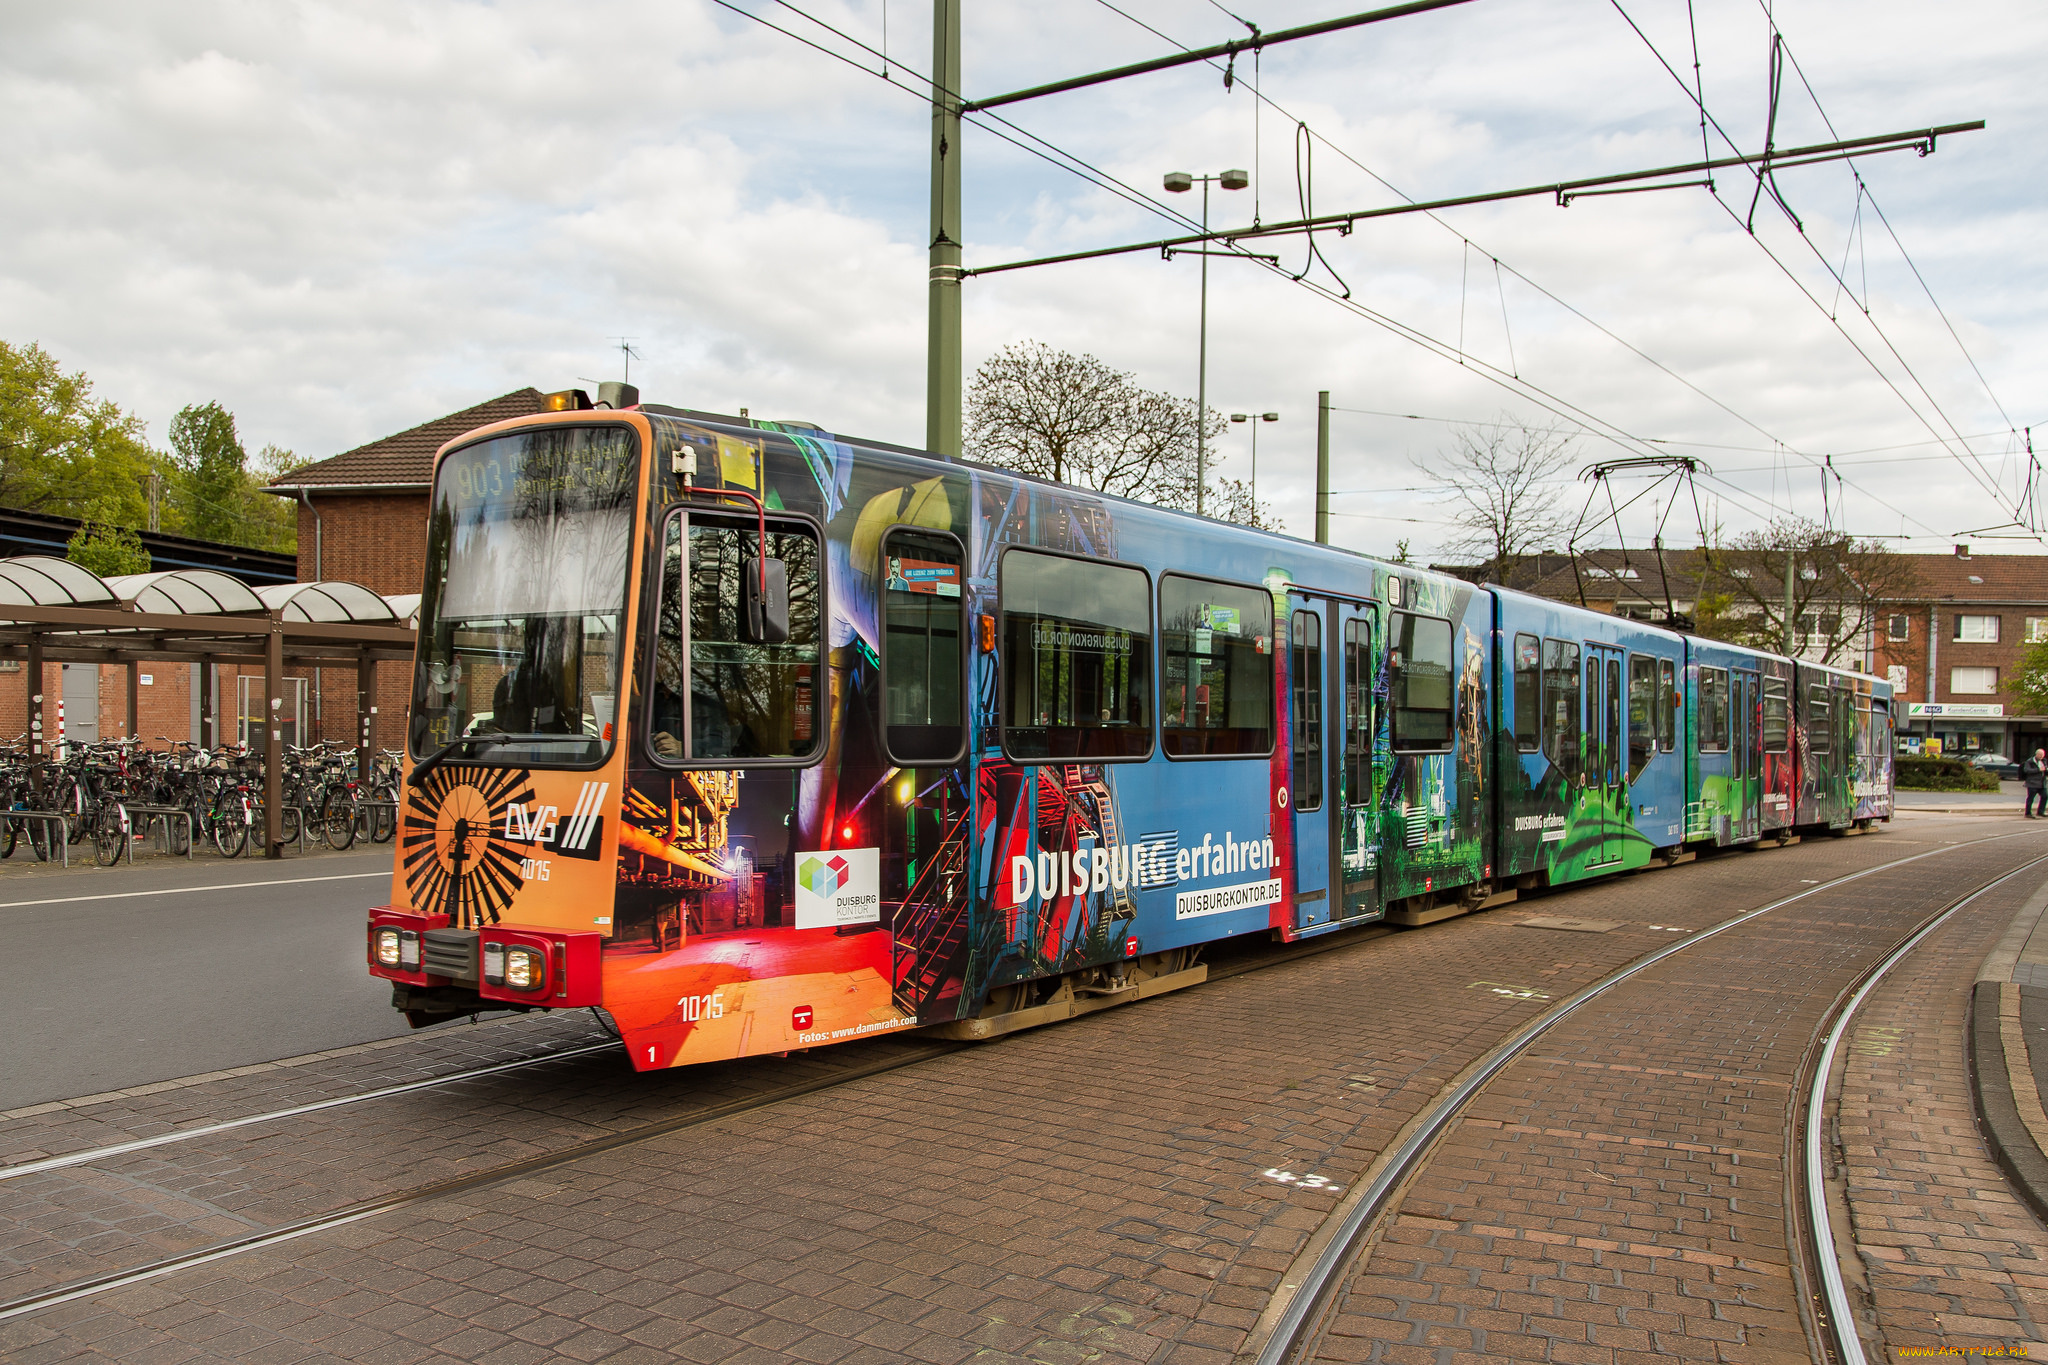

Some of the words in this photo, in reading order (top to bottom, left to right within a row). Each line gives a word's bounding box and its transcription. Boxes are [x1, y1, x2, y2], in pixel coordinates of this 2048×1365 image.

[457, 460, 503, 499] 903
[584, 466, 610, 488] Tor
[504, 803, 557, 842] DVG
[1515, 815, 1542, 831] DUISBURG
[520, 858, 551, 881] 1015
[1012, 841, 1167, 903] DUISBURG
[1176, 831, 1280, 880] erfahren.
[837, 894, 877, 907] DUISBURG
[837, 905, 869, 917] KONTOR
[1179, 882, 1280, 915] DUISBURGKONTOR.DE
[678, 993, 724, 1022] 1015
[799, 1031, 830, 1043] Fotos:
[832, 1015, 917, 1039] www.dammrath.com
[648, 1046, 656, 1063] 1
